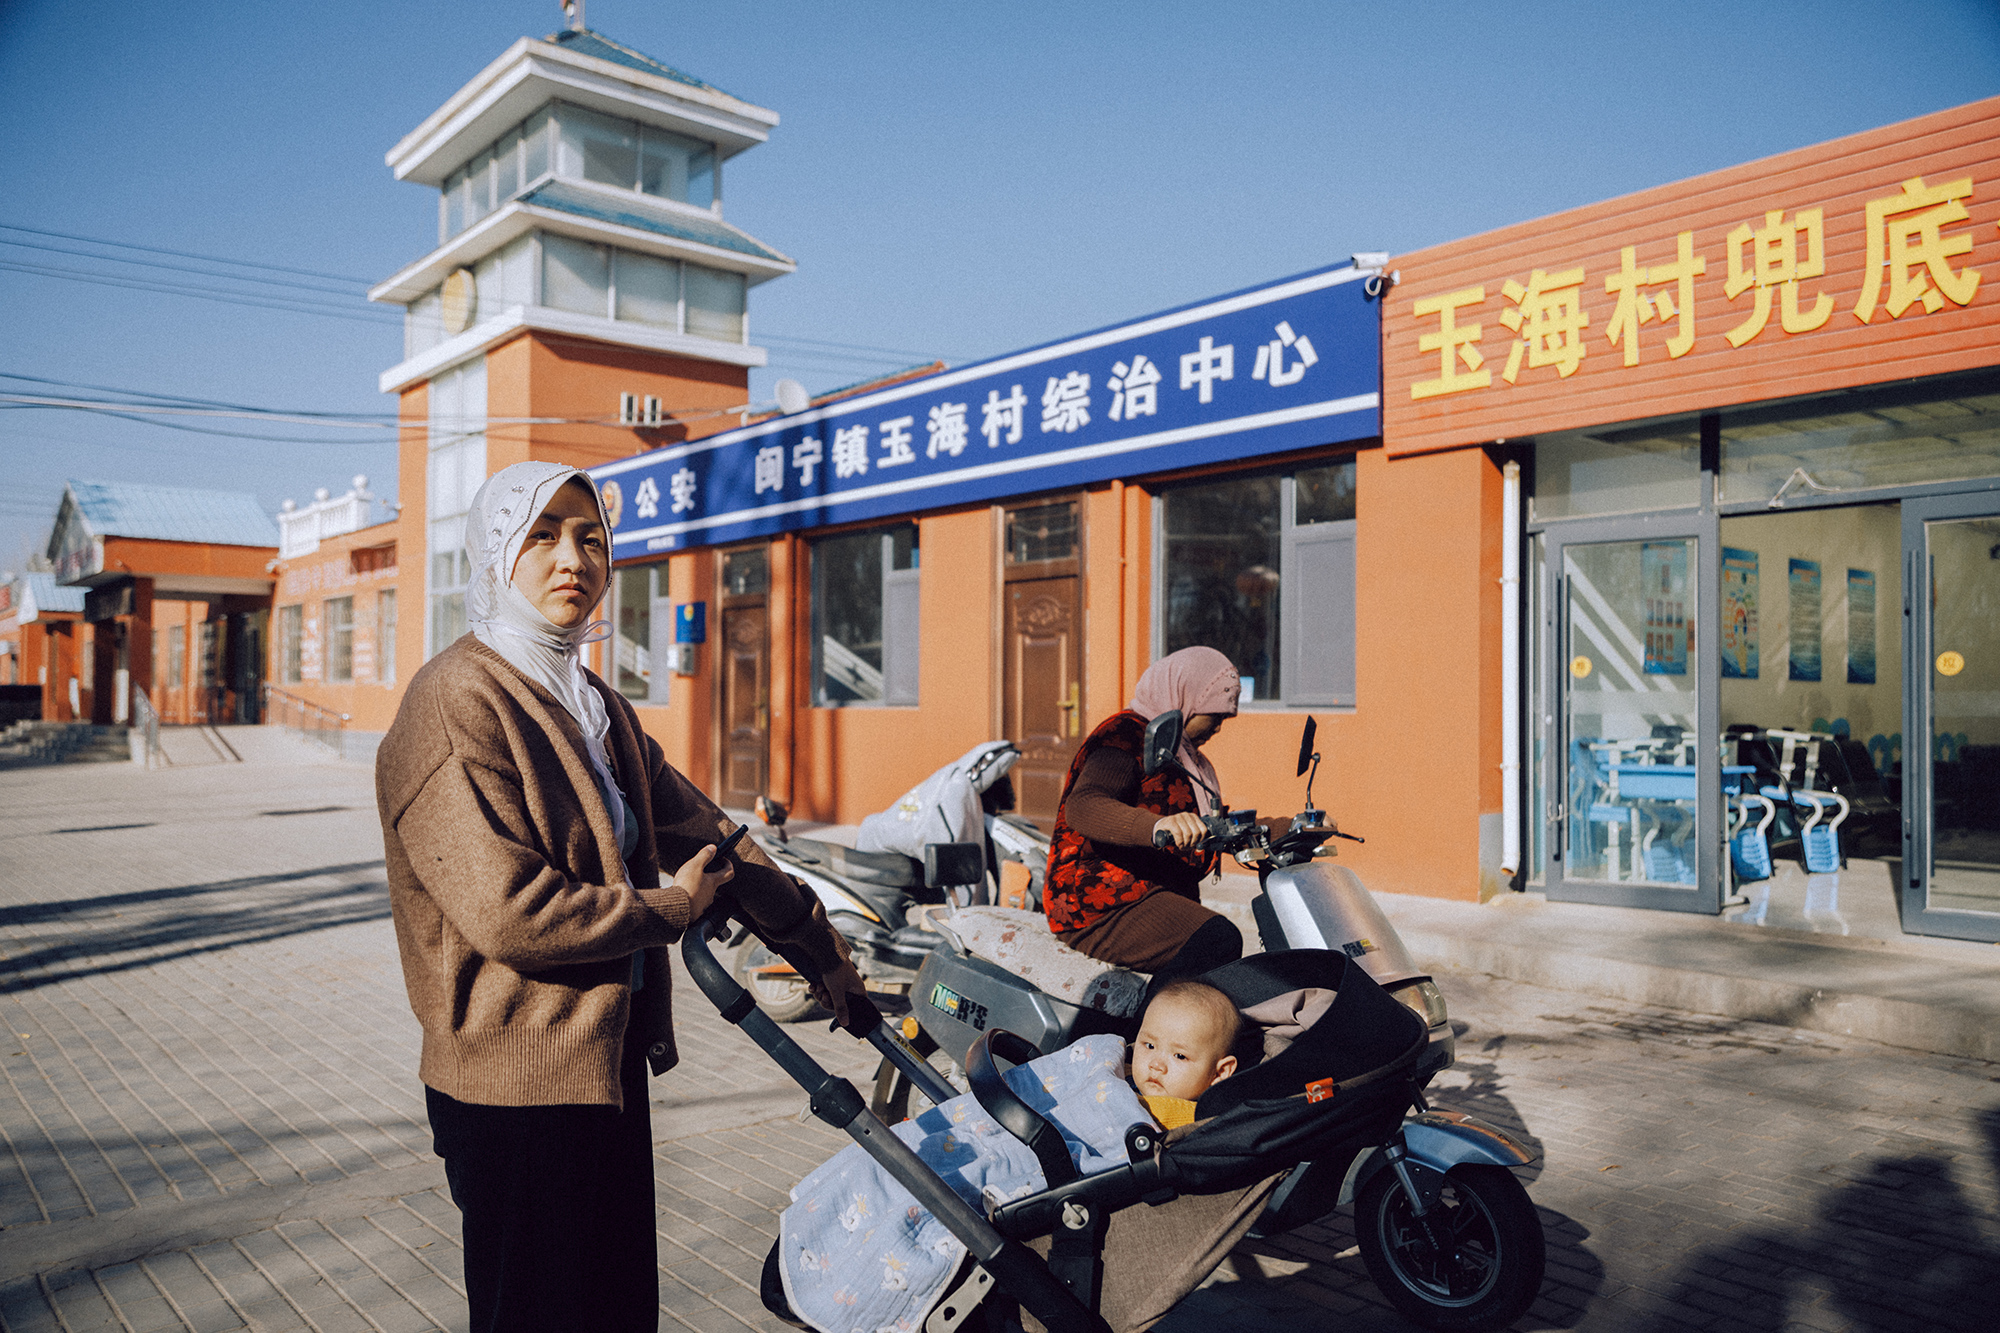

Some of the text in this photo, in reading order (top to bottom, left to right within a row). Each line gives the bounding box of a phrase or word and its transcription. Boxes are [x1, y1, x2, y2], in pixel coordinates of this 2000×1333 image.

[1410, 177, 2000, 400] 玉海村兜底
[634, 321, 1318, 518] 公安 闽宁镇玉海村综治中心
